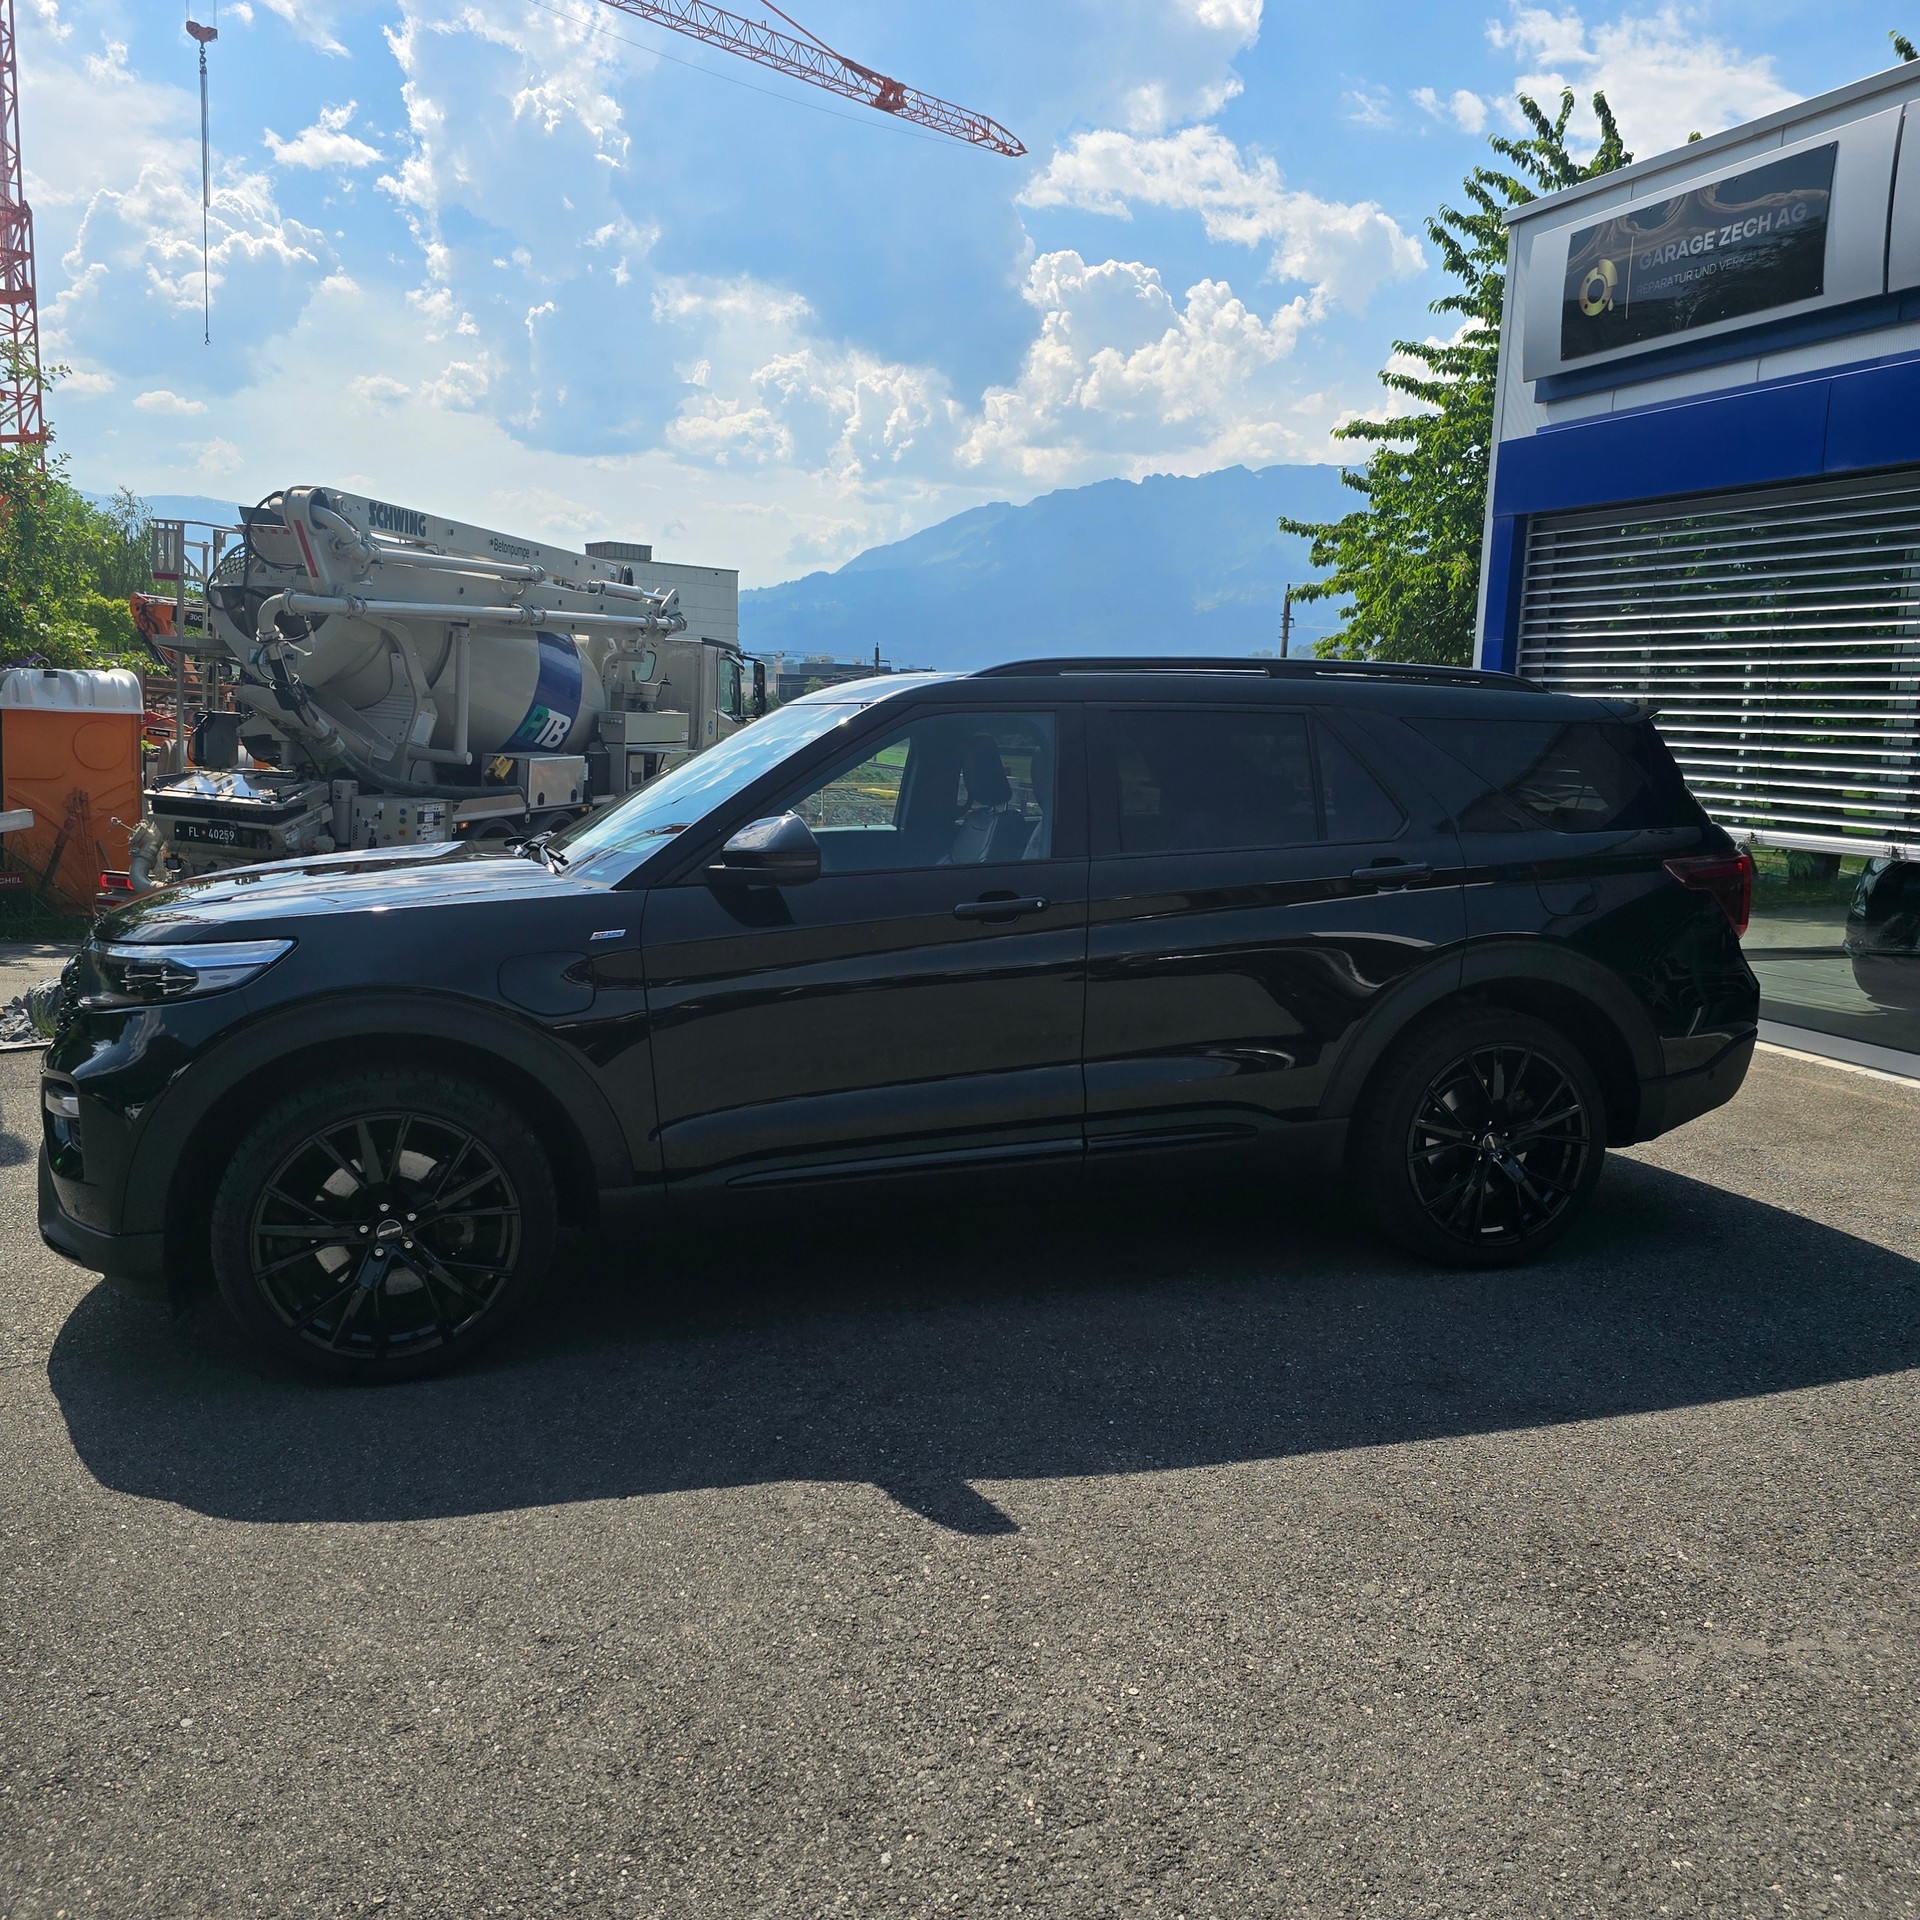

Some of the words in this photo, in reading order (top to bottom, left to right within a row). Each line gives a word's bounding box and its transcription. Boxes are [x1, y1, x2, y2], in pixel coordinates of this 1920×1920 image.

[1639, 231, 1716, 270] GARAGE
[1719, 212, 1772, 246] ZECH
[1775, 202, 1808, 228] AG
[1636, 269, 1693, 295] REPARATUR
[1694, 263, 1717, 279] UND
[368, 501, 426, 537] SCHWING
[493, 538, 530, 559] Betonpumpe
[188, 826, 199, 837] FL
[208, 828, 235, 840] 40259
